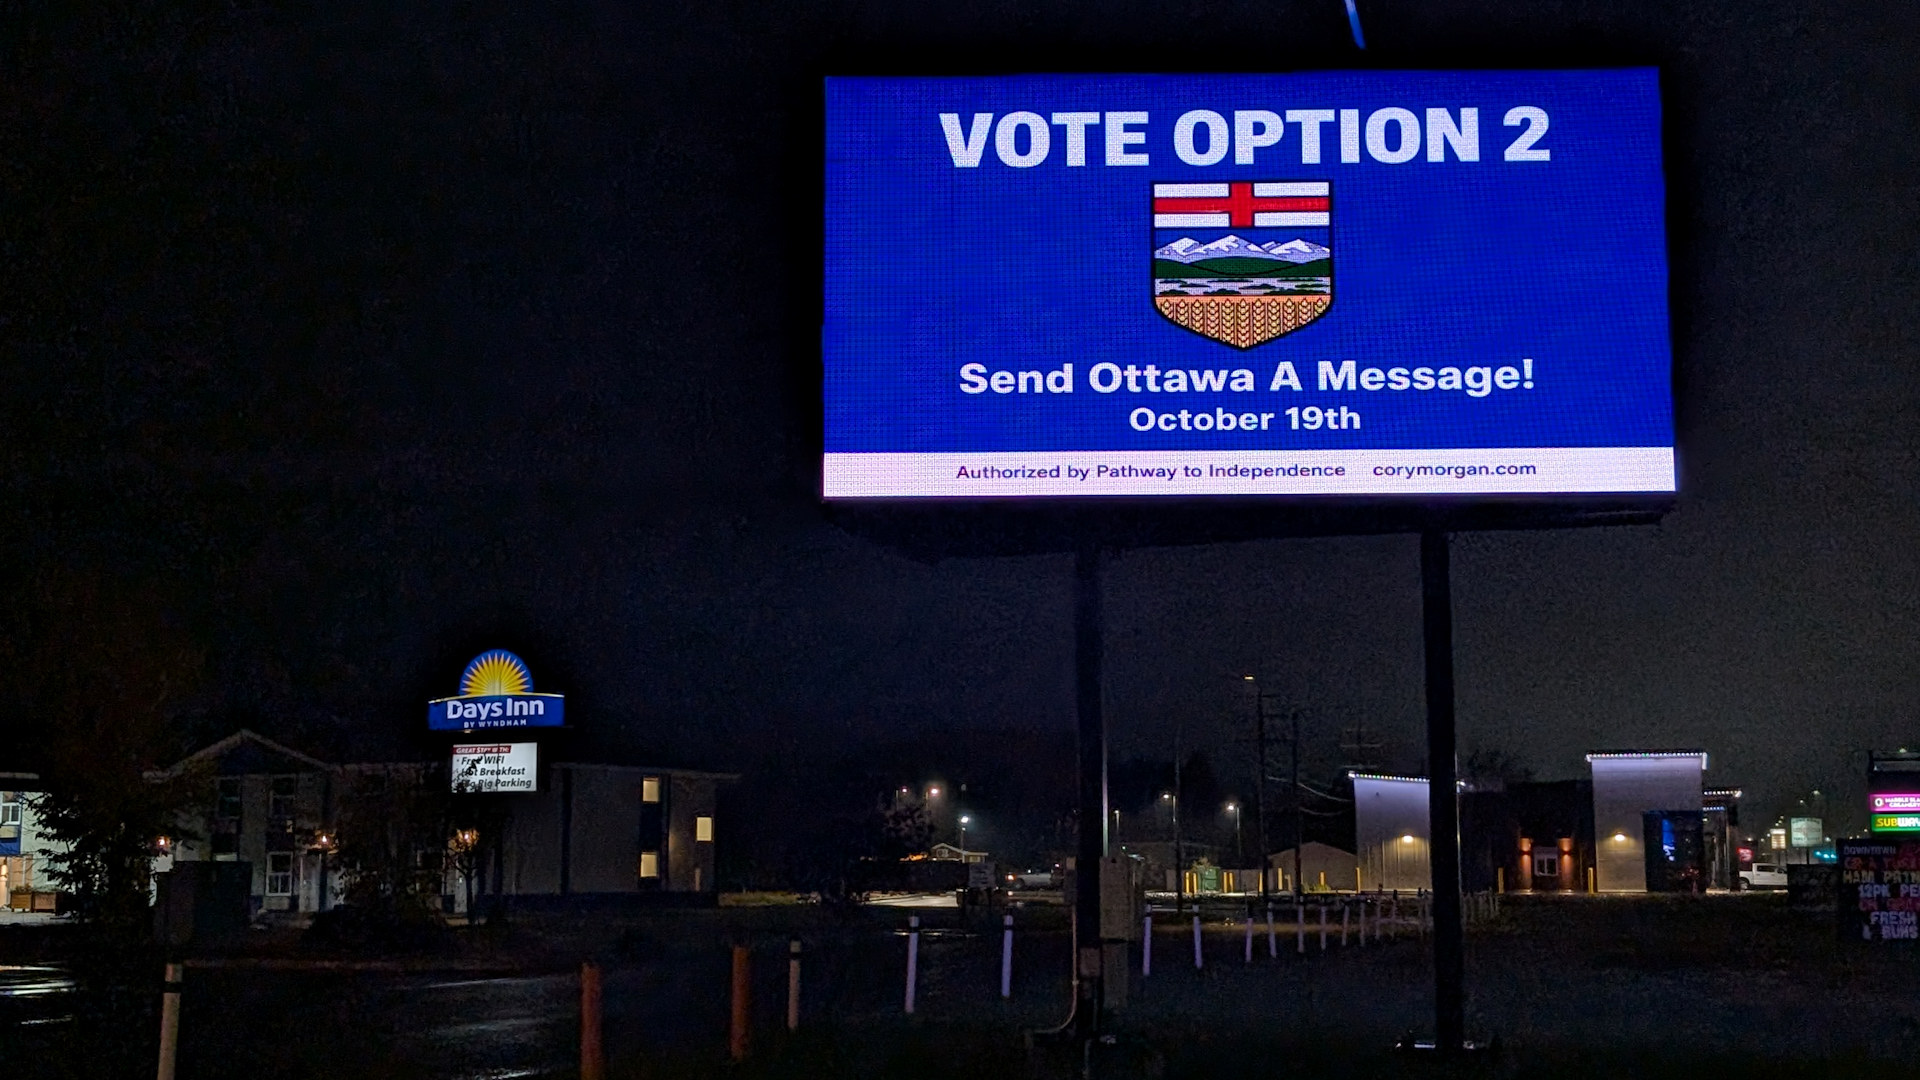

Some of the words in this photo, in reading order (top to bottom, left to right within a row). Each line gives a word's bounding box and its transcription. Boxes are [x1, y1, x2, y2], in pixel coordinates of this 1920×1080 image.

[939, 111, 1149, 168] VOTE
[1174, 107, 1479, 166] OPTION
[1503, 106, 1551, 161] 2
[959, 362, 1073, 394] Send
[1089, 362, 1254, 393] Ottawa
[1270, 361, 1302, 391] A
[1318, 359, 1534, 397] Message!
[1130, 407, 1274, 431] October
[1285, 406, 1361, 430] 19th
[956, 465, 1060, 479] Authorized
[1067, 464, 1090, 482] by
[1097, 464, 1177, 481] Pathway
[1183, 466, 1202, 478] to
[1209, 463, 1346, 480] Independence
[1373, 463, 1537, 480] corymorgan.com
[447, 700, 502, 720] Days
[506, 698, 544, 716] Inn
[478, 719, 527, 728] WYNDHAM
[480, 766, 526, 776] Breakfast
[495, 777, 532, 789] Parking
[1869, 910, 1918, 925] FRESH
